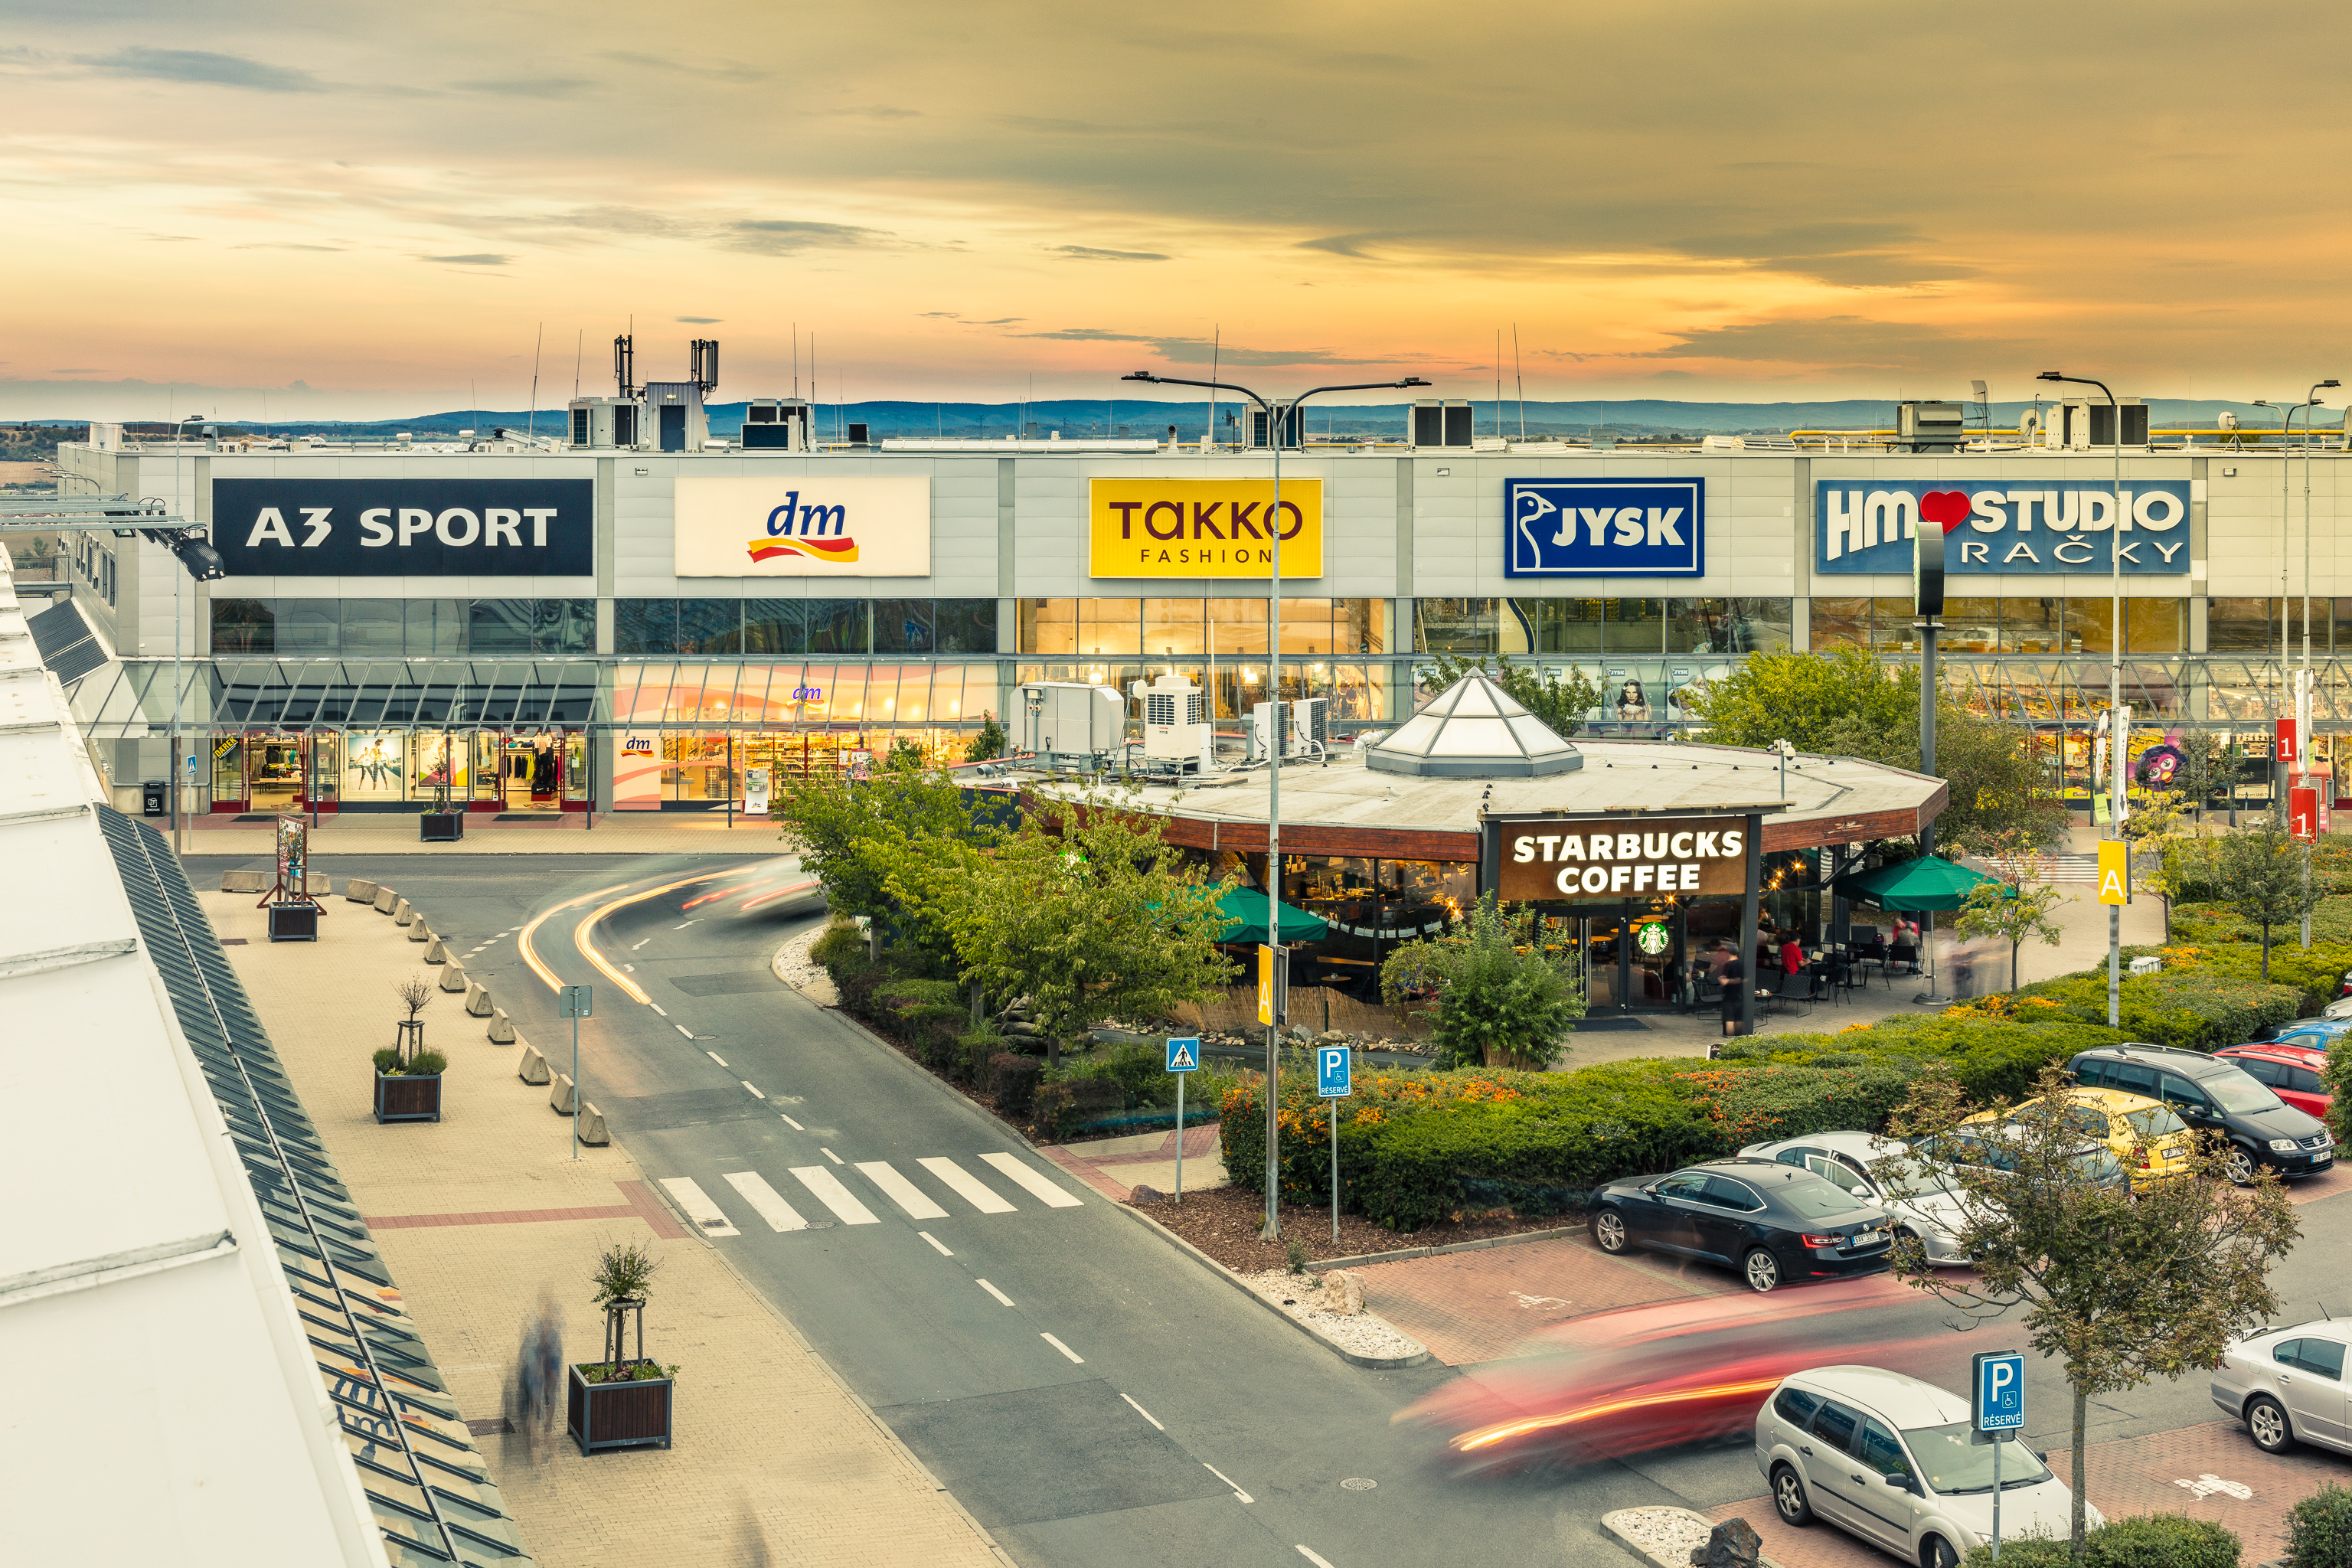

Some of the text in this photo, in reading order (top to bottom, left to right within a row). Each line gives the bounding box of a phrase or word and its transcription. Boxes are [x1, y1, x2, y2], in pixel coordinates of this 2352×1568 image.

[246, 508, 557, 547] A3 SPORT
[767, 491, 845, 536] dm
[1551, 507, 1686, 547] JYSK
[1827, 490, 2184, 561] HM STUDIO
[1141, 549, 1272, 563] FASHION
[1962, 534, 2184, 564] RAČKY
[214, 736, 237, 758] DAREK
[626, 736, 650, 750] dm
[2281, 737, 2293, 757] 1
[2292, 813, 2311, 838] 1
[1513, 830, 1743, 863] STARBUCKS
[1557, 864, 1700, 893] COFFEE
[2100, 870, 2124, 897] A
[1259, 981, 1270, 1016] A
[1326, 1051, 1342, 1078] P
[1321, 1085, 1348, 1094] RÉSERVÉ
[1991, 1362, 2014, 1402] P
[1984, 1410, 2021, 1426] RÉSERVÉ
